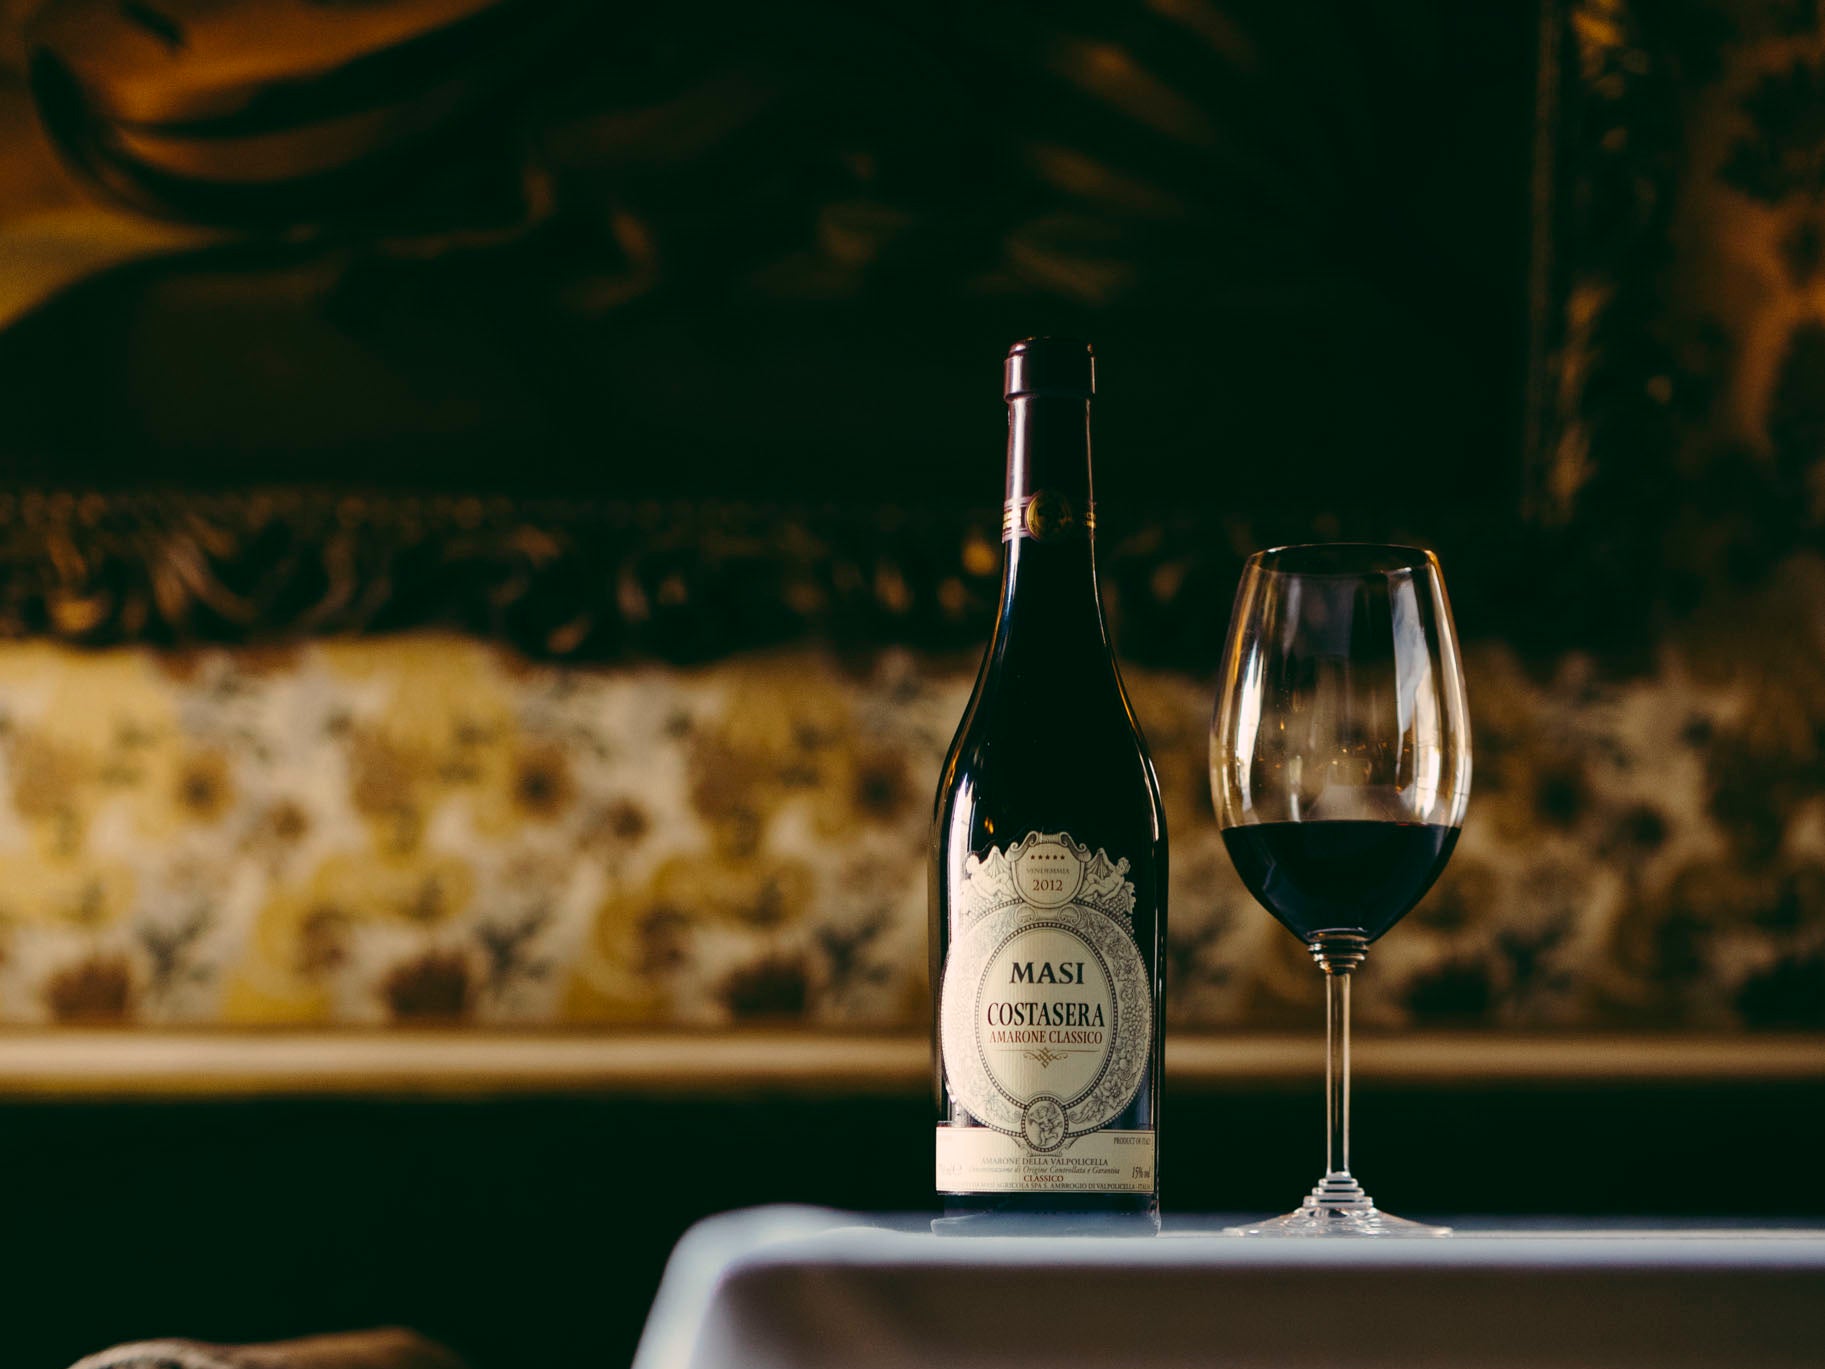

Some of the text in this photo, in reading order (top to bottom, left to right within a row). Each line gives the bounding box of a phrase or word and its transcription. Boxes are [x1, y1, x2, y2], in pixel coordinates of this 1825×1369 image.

[1032, 879, 1063, 891] 2012
[1009, 962, 1085, 984] MASI
[987, 1002, 1105, 1027] COSTASERA
[990, 1031, 1102, 1044] AMARONE CLASSICO
[1022, 1157, 1048, 1166] DELLA
[1050, 1158, 1108, 1166] VALPOLICELLA
[1022, 1165, 1047, 1175] Origine
[1049, 1166, 1086, 1175] Controllata
[1023, 1174, 1064, 1183] CLASSICO
